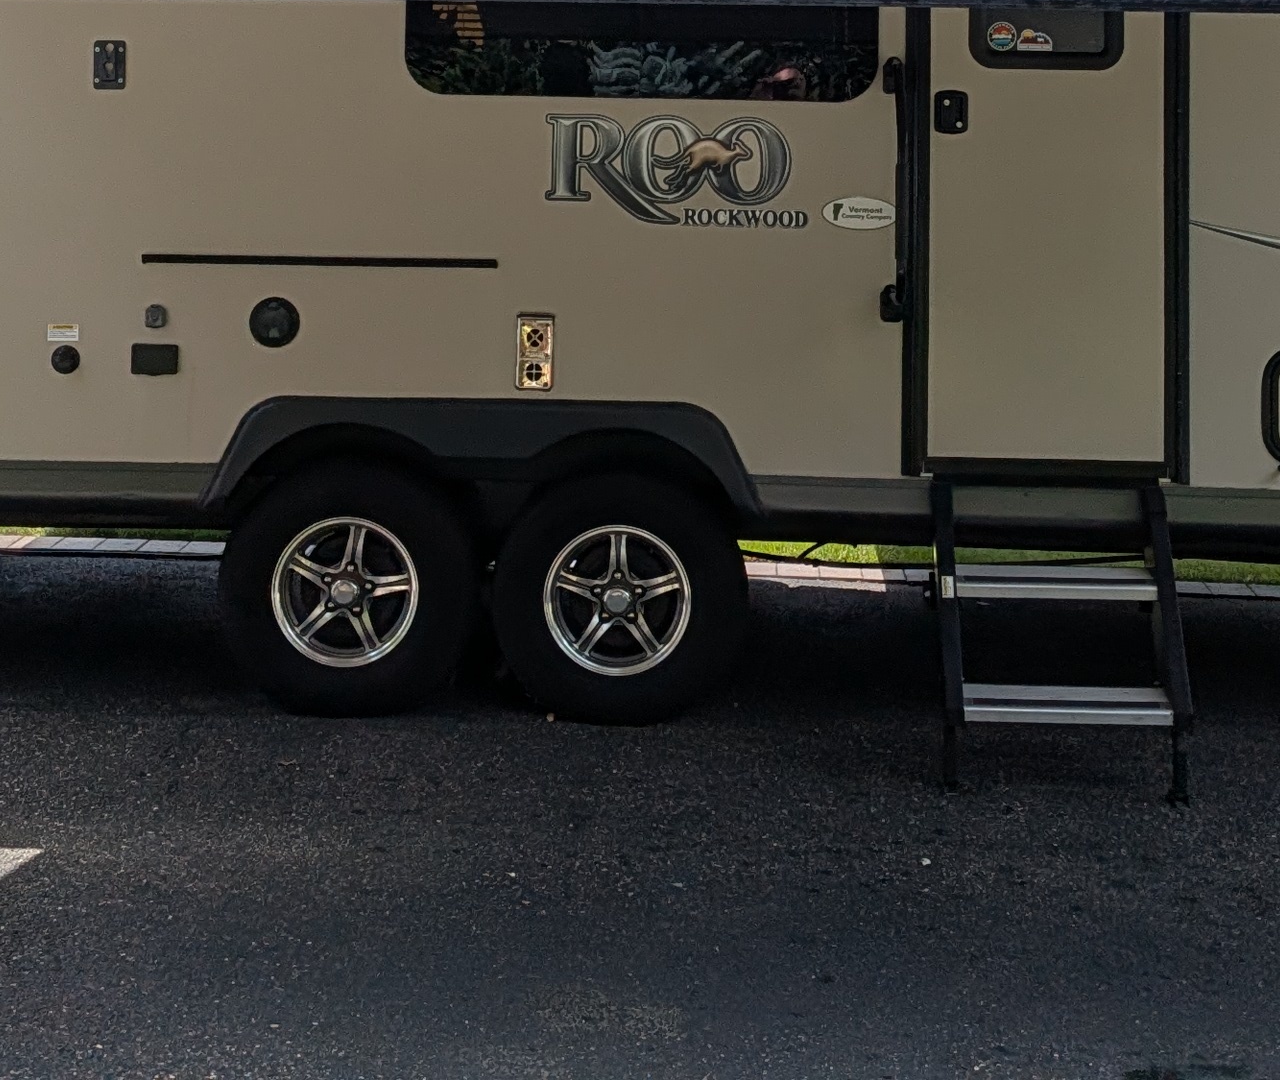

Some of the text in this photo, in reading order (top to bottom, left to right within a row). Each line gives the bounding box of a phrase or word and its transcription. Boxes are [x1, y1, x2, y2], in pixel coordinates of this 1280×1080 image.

[545, 113, 792, 225] ROO
[680, 207, 808, 229] ROCKWOOD
[848, 206, 883, 214] Vermont
